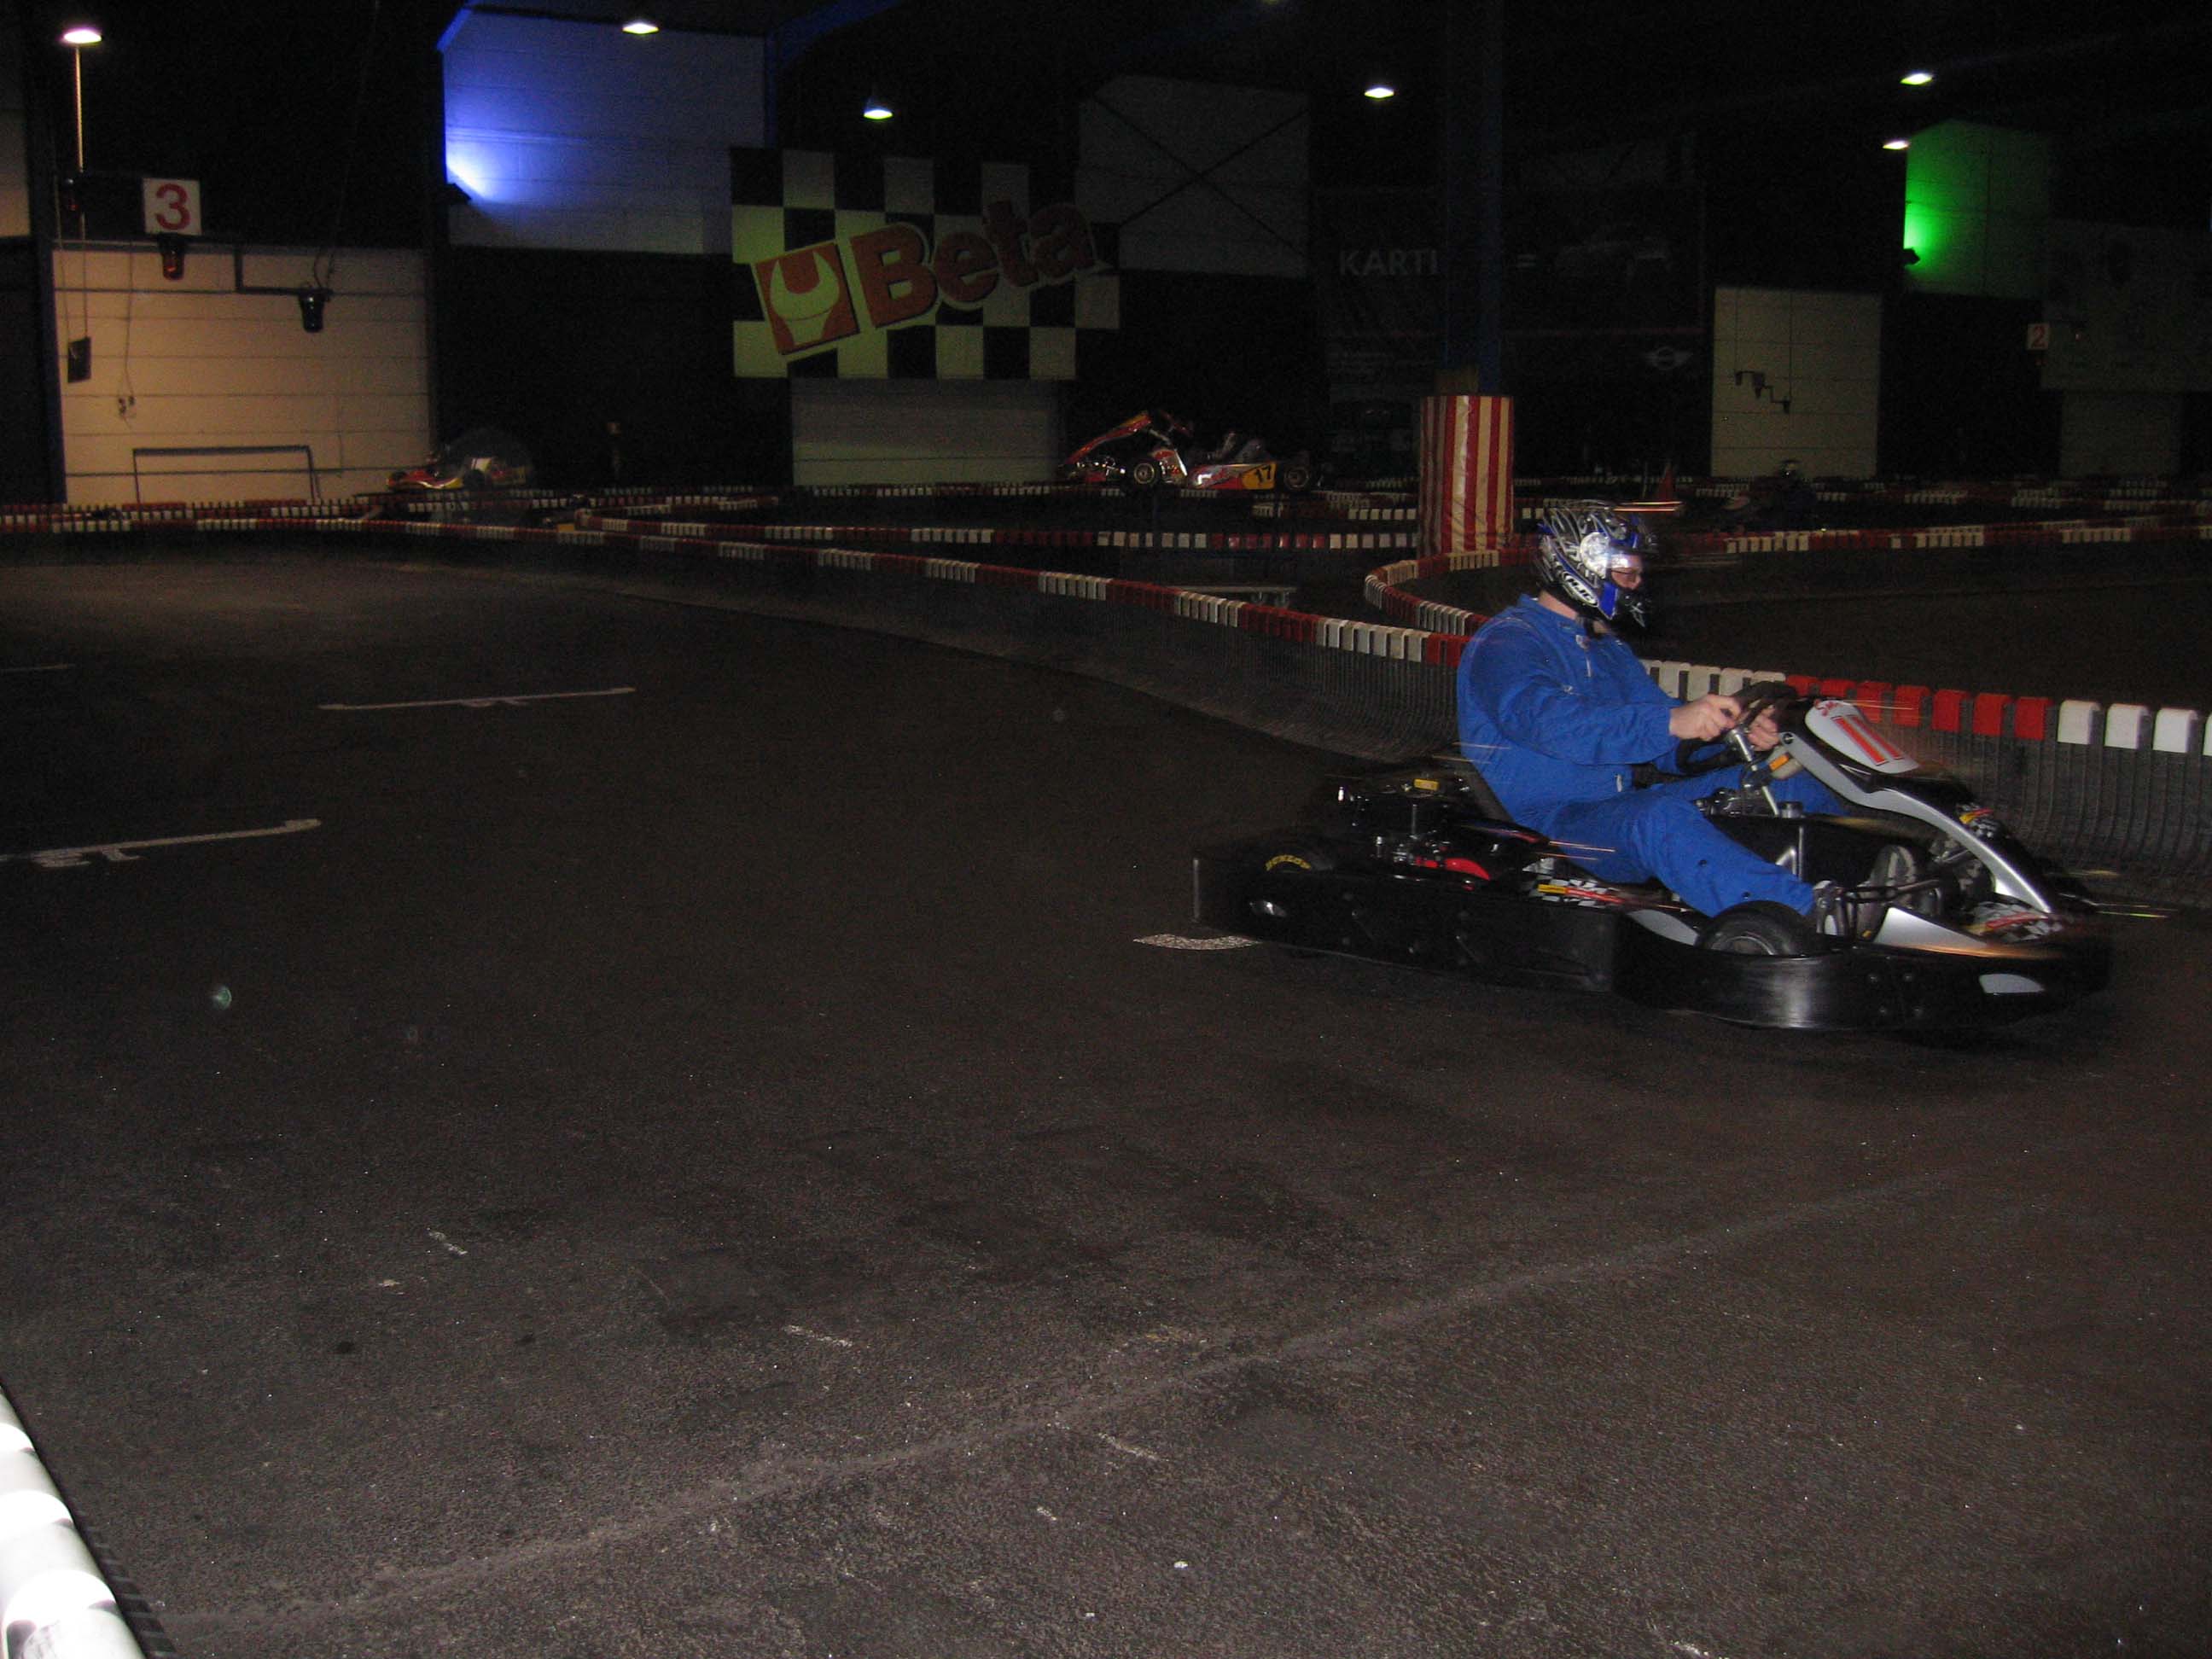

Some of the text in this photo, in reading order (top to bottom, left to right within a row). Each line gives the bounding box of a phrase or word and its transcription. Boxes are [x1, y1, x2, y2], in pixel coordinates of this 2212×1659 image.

[155, 183, 192, 231] 3
[850, 200, 1096, 329] Beta
[1339, 248, 1438, 276] KARTI
[2031, 325, 2046, 348] 2
[1255, 463, 1272, 484] 17
